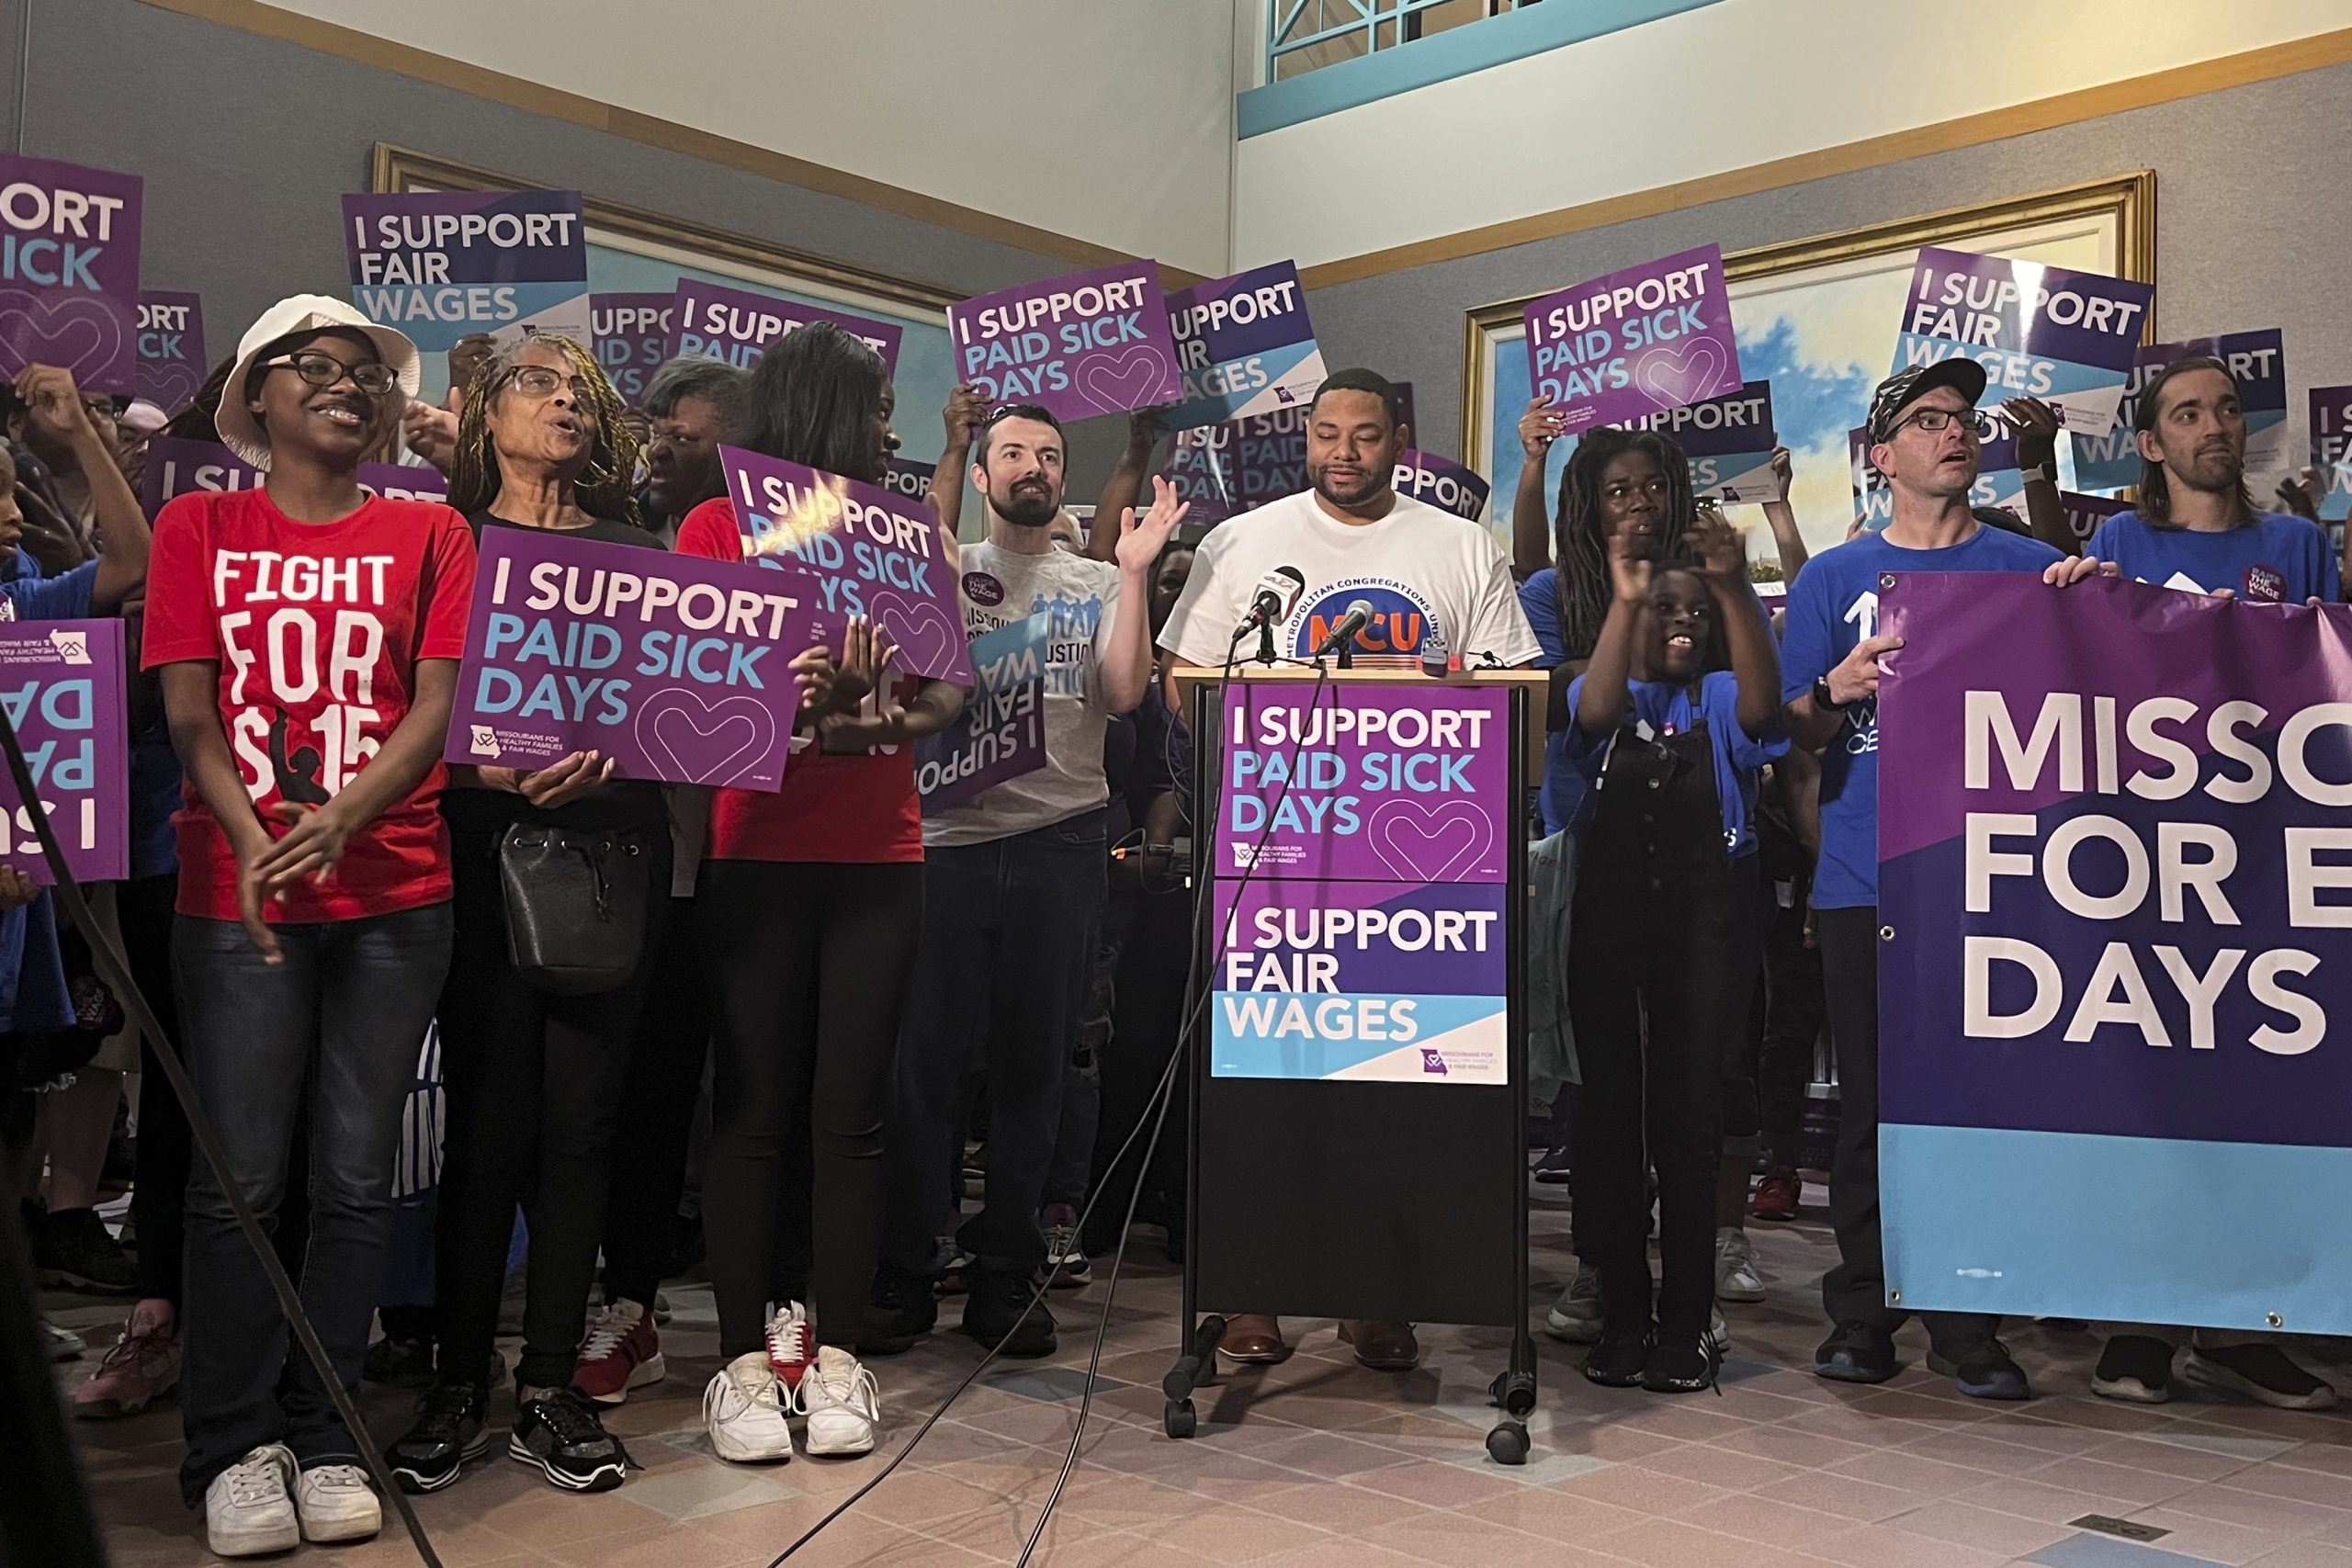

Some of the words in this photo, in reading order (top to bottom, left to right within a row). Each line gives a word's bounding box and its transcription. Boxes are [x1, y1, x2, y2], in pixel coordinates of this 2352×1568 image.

[356, 216, 366, 249] I
[379, 213, 577, 249] SUPPORT
[360, 253, 450, 285] FAIR
[1918, 269, 1933, 300] I
[362, 288, 518, 321] WAGES
[683, 298, 695, 328] I
[959, 318, 970, 344] I
[979, 276, 1148, 339] SUPPORT
[1170, 280, 1295, 341] UPPORT
[1532, 318, 1541, 345] I
[1549, 264, 1709, 340] SUPPORT
[1911, 303, 2001, 348] FAIR
[966, 332, 1050, 375] PAID
[1060, 310, 1148, 354] SICK
[1536, 330, 1612, 378] PAID
[1621, 300, 1708, 351] SICK
[972, 360, 1069, 401] DAYS
[1182, 358, 1268, 404] AGES
[1539, 358, 1629, 408] DAYS
[162, 461, 175, 500] I
[1391, 464, 1482, 521] PPORT
[738, 469, 754, 507] I
[762, 476, 931, 558] SUPPORT
[214, 548, 393, 607] FIGHT
[749, 513, 844, 570] PAID
[853, 541, 936, 598] SICK
[492, 558, 511, 604] I
[525, 562, 797, 640] SUPPORT
[969, 587, 998, 599] WAGE
[2248, 580, 2279, 600] WAGE
[2251, 573, 2270, 588] THE
[1286, 583, 1335, 659] METROPOLITAN
[1337, 578, 1431, 611] CONGREGATIONS
[220, 608, 384, 705] FOR
[483, 613, 622, 669] PAID
[636, 630, 770, 689] SICK
[474, 667, 632, 725] DAYS
[969, 679, 1035, 738] FAIR
[500, 738, 532, 746] HEALTHY
[532, 741, 563, 750] FAMILIES
[1028, 716, 1036, 749] I
[1233, 705, 1244, 744] I
[1259, 705, 1491, 749] SUPPORT
[526, 748, 551, 756] WAGES
[913, 722, 1017, 795] SUPPO
[1232, 750, 1346, 790] PAID
[1360, 752, 1476, 793] SICK
[81, 798, 95, 849] I
[1232, 795, 1360, 835] DAYS
[1964, 812, 2242, 926] FOR
[1227, 908, 1237, 948] I
[1253, 908, 1497, 952] SUPPORT
[1227, 953, 1340, 994] FAIR
[1963, 935, 2326, 1055] DAYS
[1223, 998, 1418, 1042] WAGES
